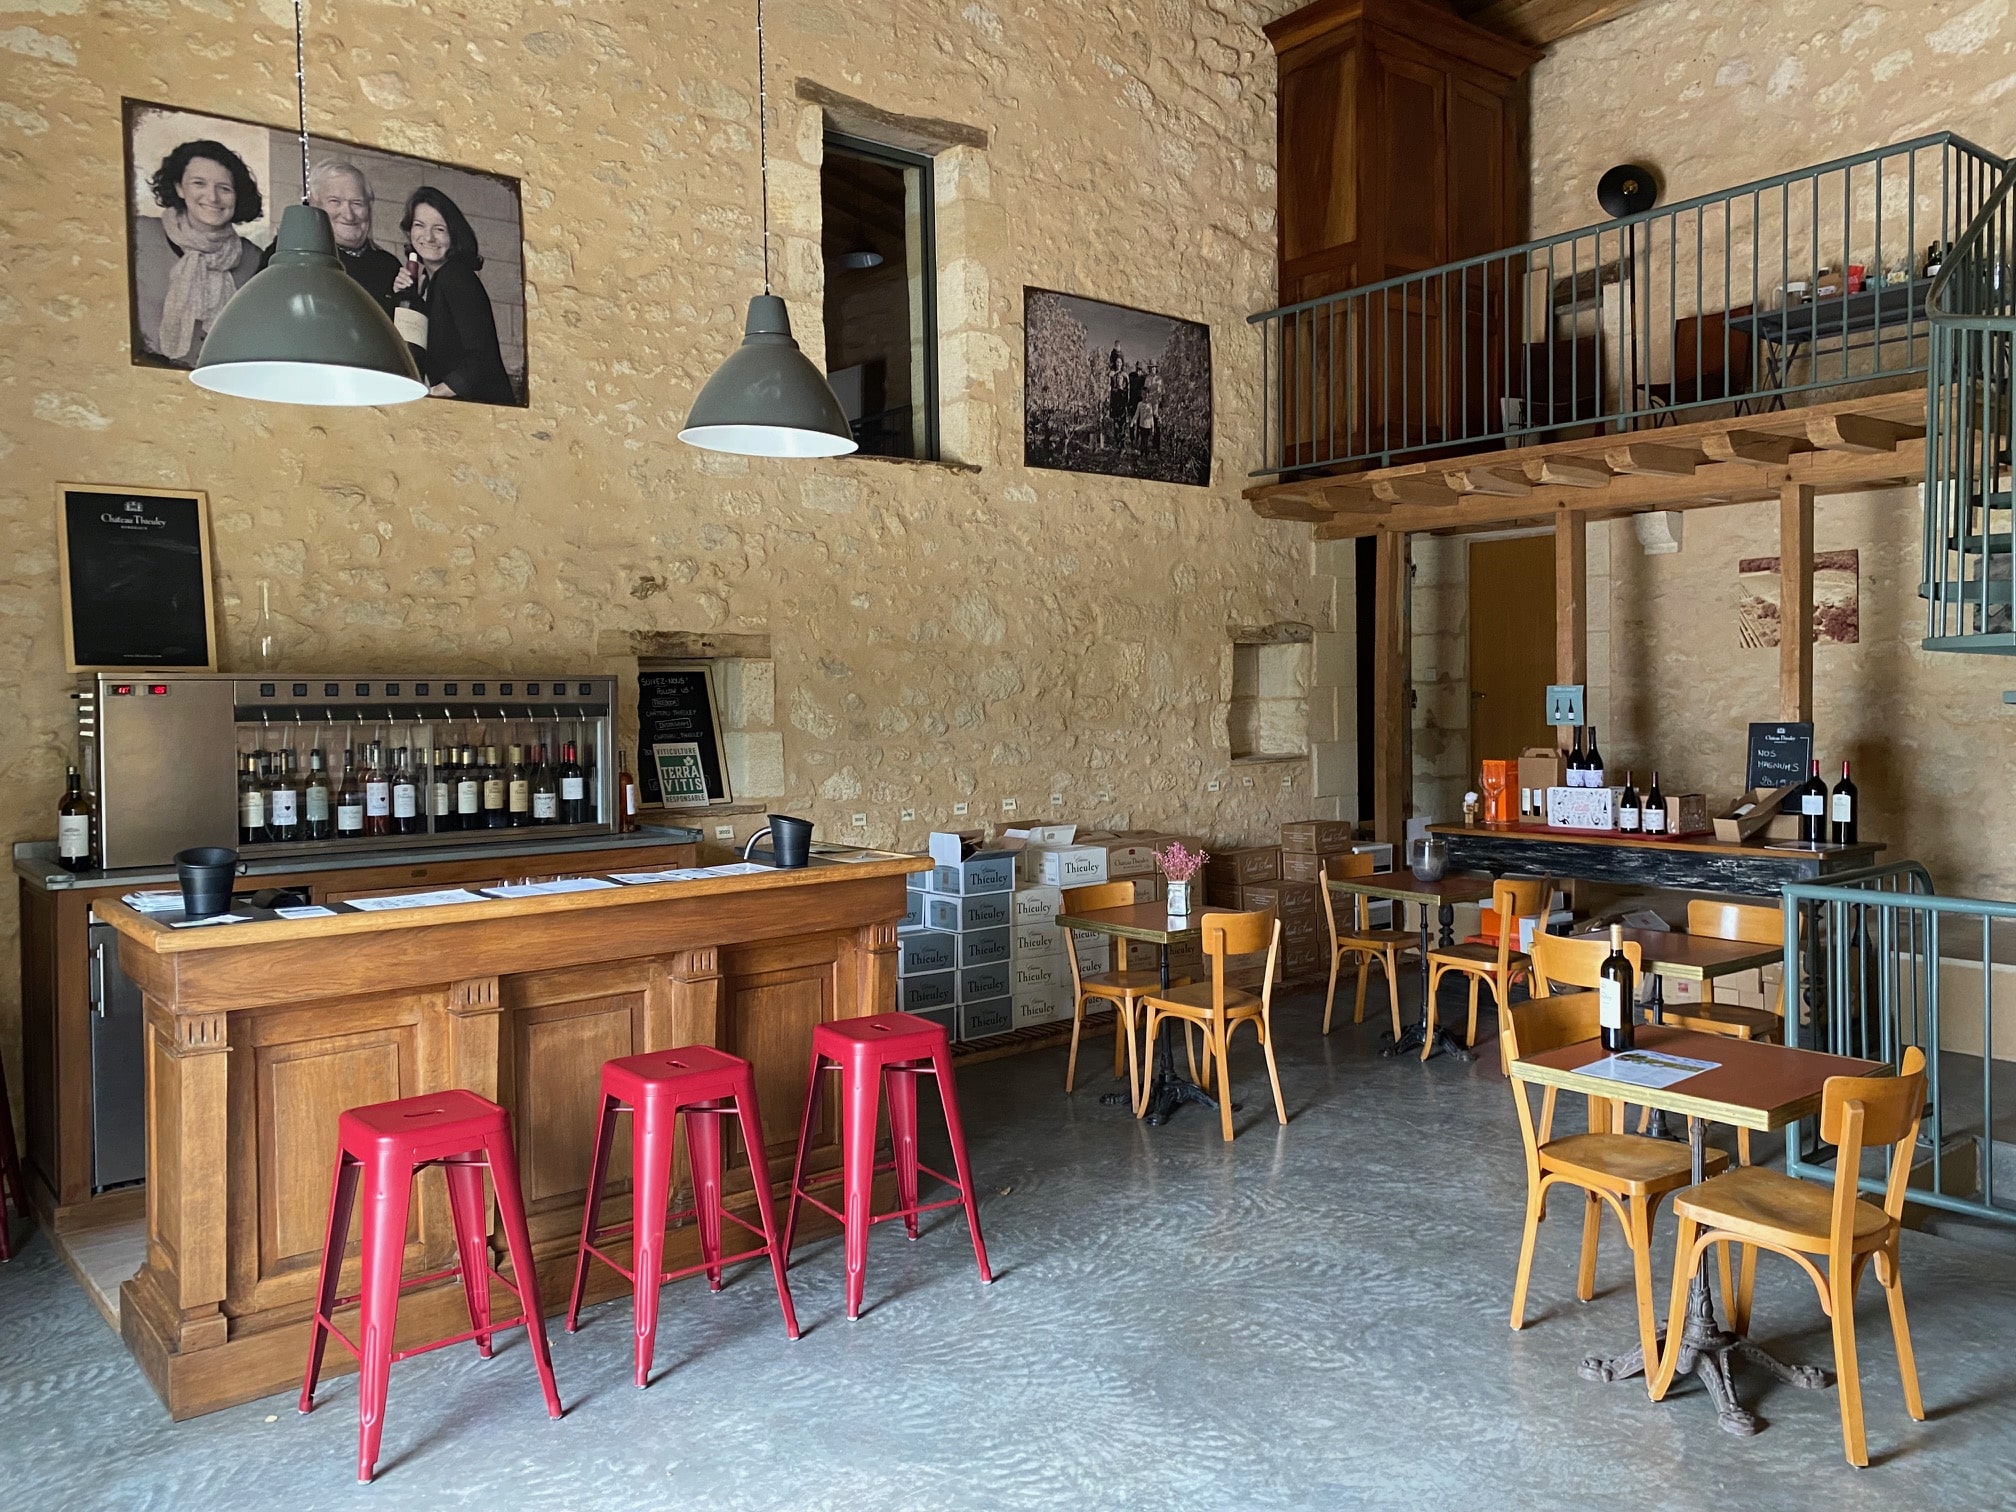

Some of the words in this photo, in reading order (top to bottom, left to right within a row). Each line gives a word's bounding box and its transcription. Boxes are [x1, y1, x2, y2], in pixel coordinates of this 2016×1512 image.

[656, 747, 697, 755] VITICULTURE
[1758, 749, 1776, 758] NOS
[661, 766, 699, 779] TERRA
[1757, 761, 1799, 772] MAGNUMS
[664, 778, 703, 792] VITIS
[665, 794, 706, 803] RESPONSABLE
[1065, 860, 1099, 875] Thieuley
[970, 871, 1008, 887] Thieuley
[968, 907, 1005, 922] Thieuley
[1017, 901, 1052, 915] Thieuley
[1017, 935, 1053, 948] Thieuley
[969, 942, 1006, 957] Thieuley
[909, 950, 949, 966] Thieuley
[1017, 969, 1052, 983] Thieuley
[968, 977, 1005, 993] Thieuley
[1021, 1002, 1056, 1017] Thieuley
[970, 1013, 1008, 1028] Thieuley
